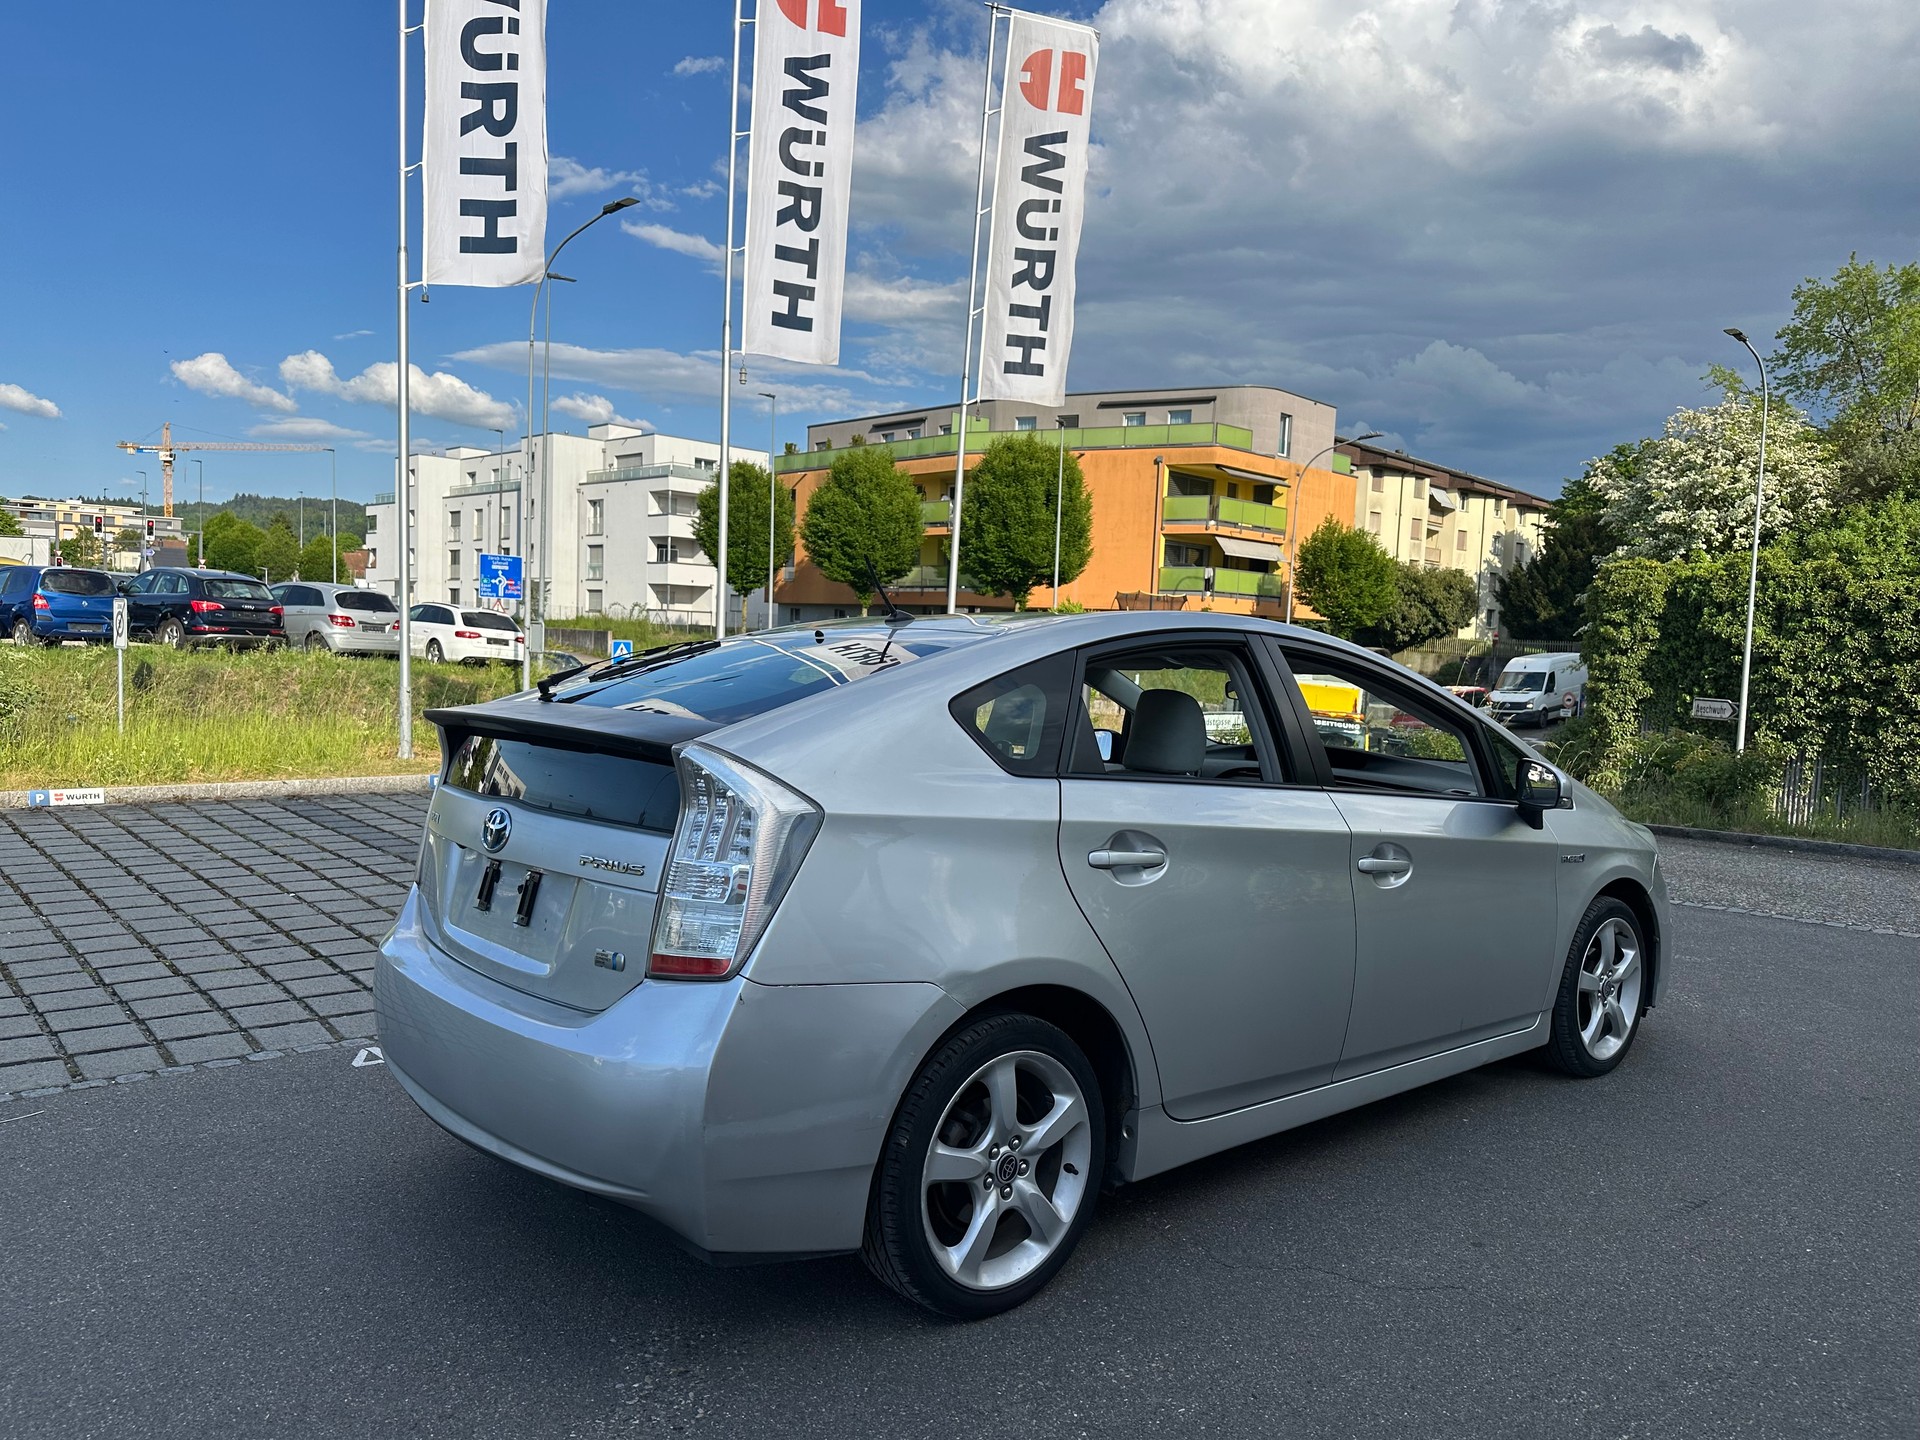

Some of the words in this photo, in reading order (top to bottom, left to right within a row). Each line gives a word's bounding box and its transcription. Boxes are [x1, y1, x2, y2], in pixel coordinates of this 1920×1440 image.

[459, 0, 519, 254] ÜRTH
[770, 53, 831, 333] WÜRTH
[1003, 130, 1069, 377] WÜRTH
[35, 793, 45, 804] P
[579, 854, 646, 876] PRIUS
